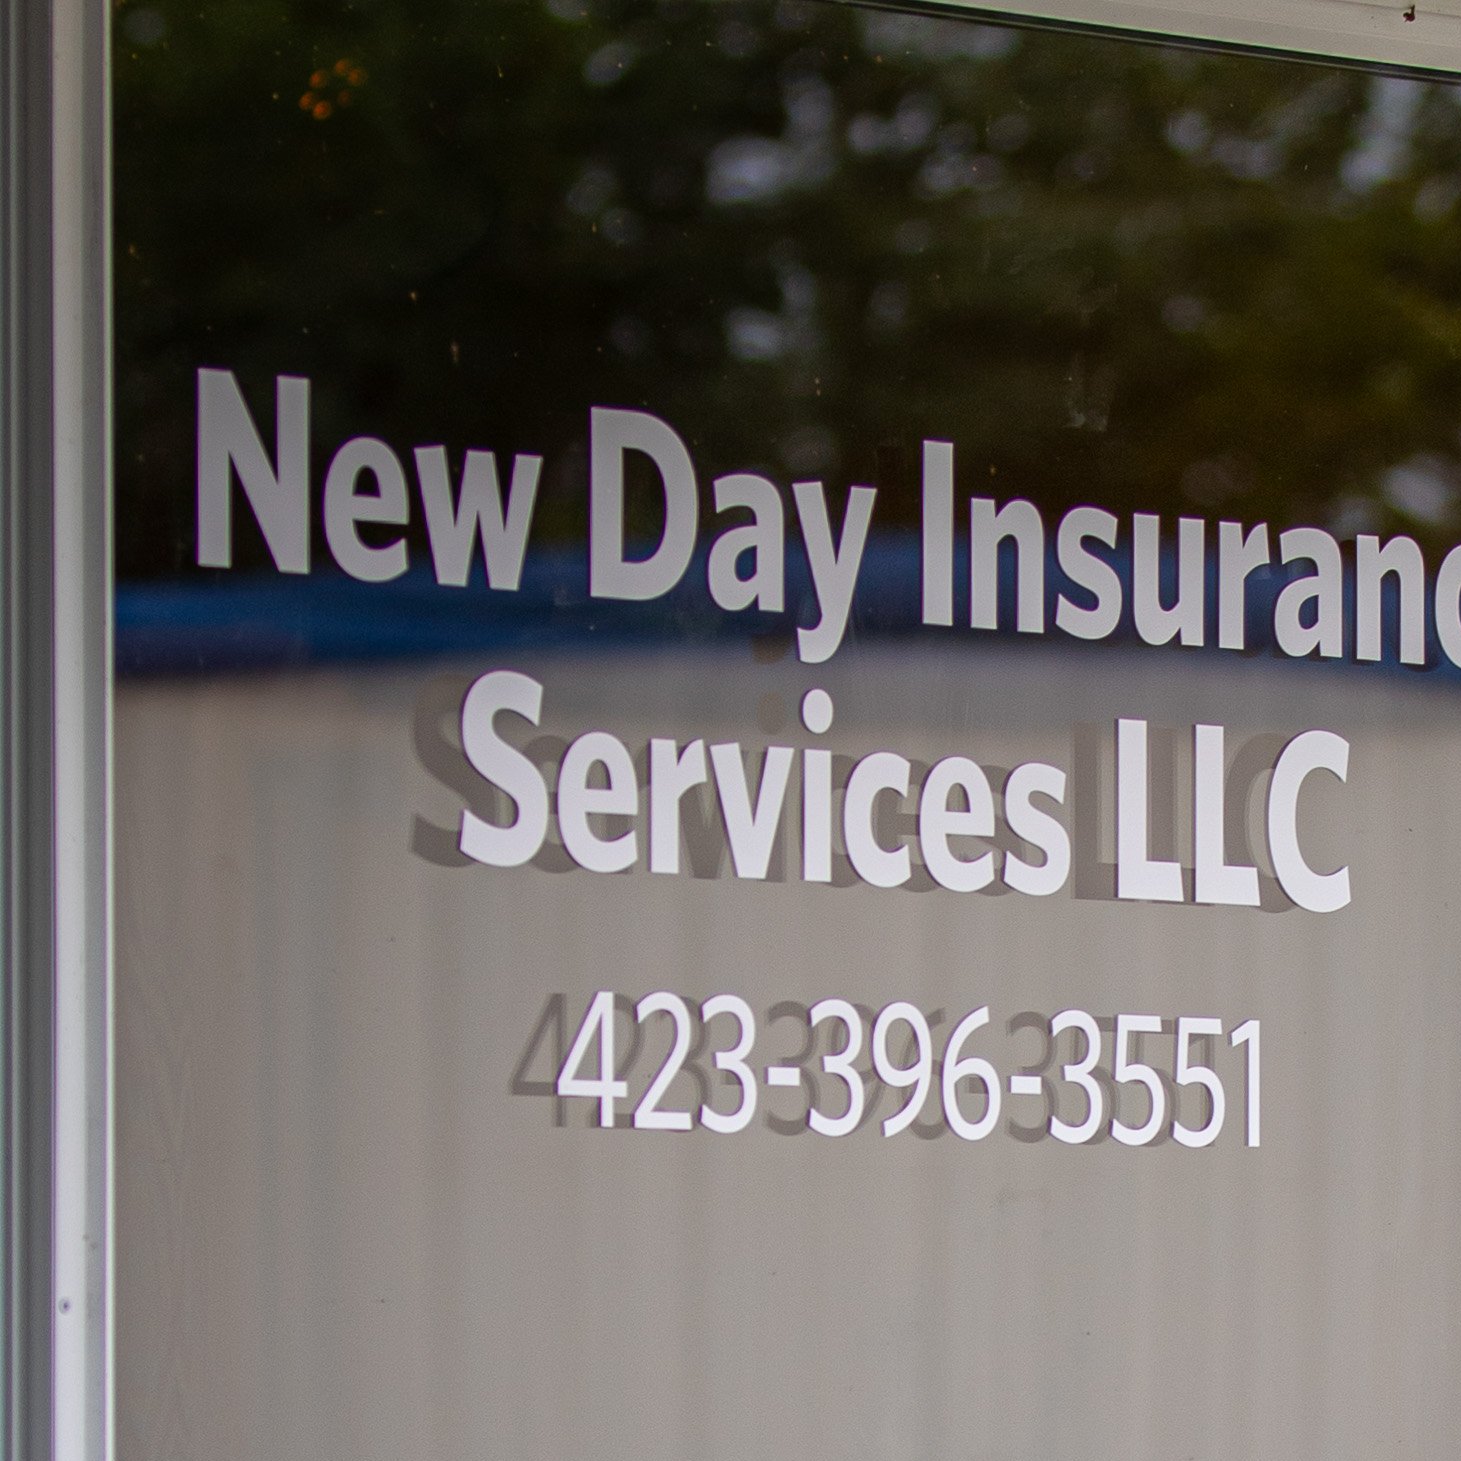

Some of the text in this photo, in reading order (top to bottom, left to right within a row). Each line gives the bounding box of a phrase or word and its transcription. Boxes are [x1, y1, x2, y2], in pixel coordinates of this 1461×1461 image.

[197, 367, 544, 592] New
[590, 406, 879, 664] Day
[460, 669, 1352, 913] Services LLC
[556, 990, 1261, 1148] 423-396-3551
